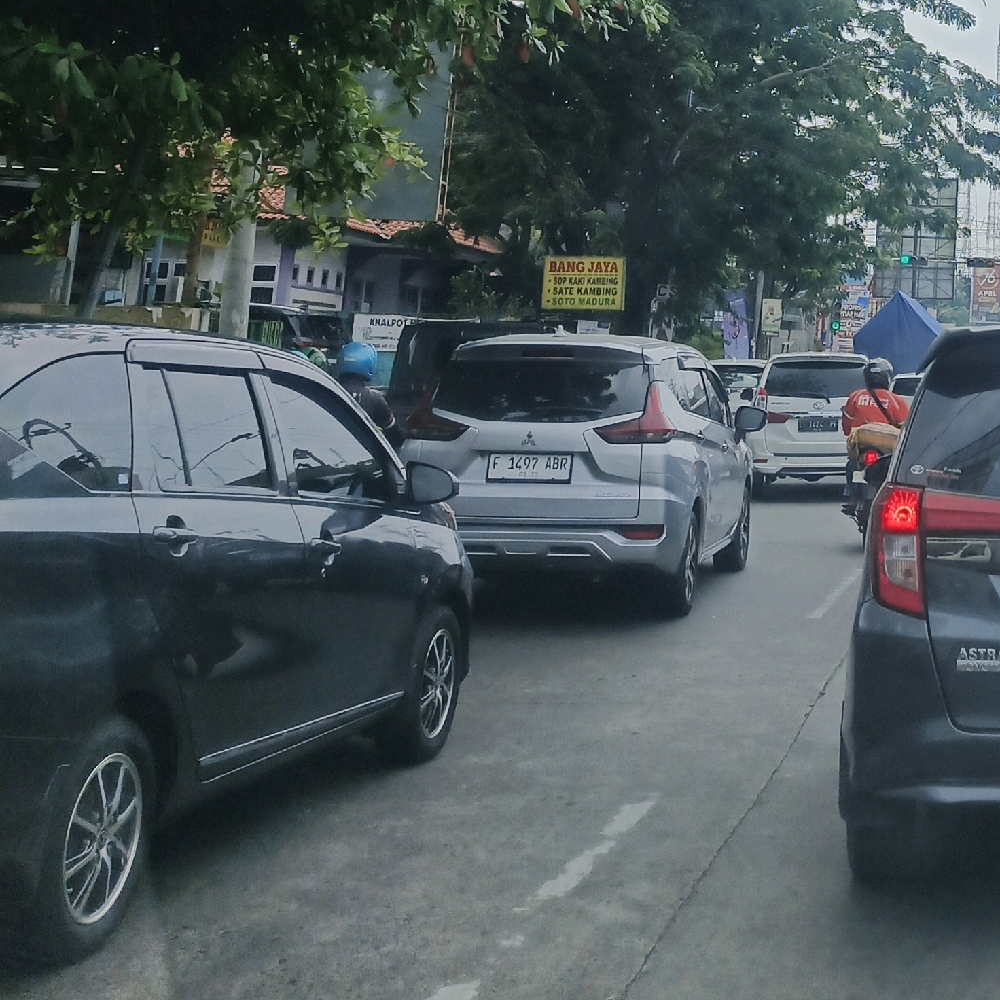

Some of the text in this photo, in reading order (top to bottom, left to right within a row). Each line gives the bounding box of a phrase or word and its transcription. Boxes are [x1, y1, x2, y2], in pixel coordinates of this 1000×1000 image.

[549, 260, 619, 274] BANG JAYA
[553, 276, 618, 286] SOP KAKI KAMBING
[553, 286, 618, 296] SATE KAMBING
[552, 297, 616, 306] SOTO MADURA
[492, 456, 568, 471] F 1497 ABR
